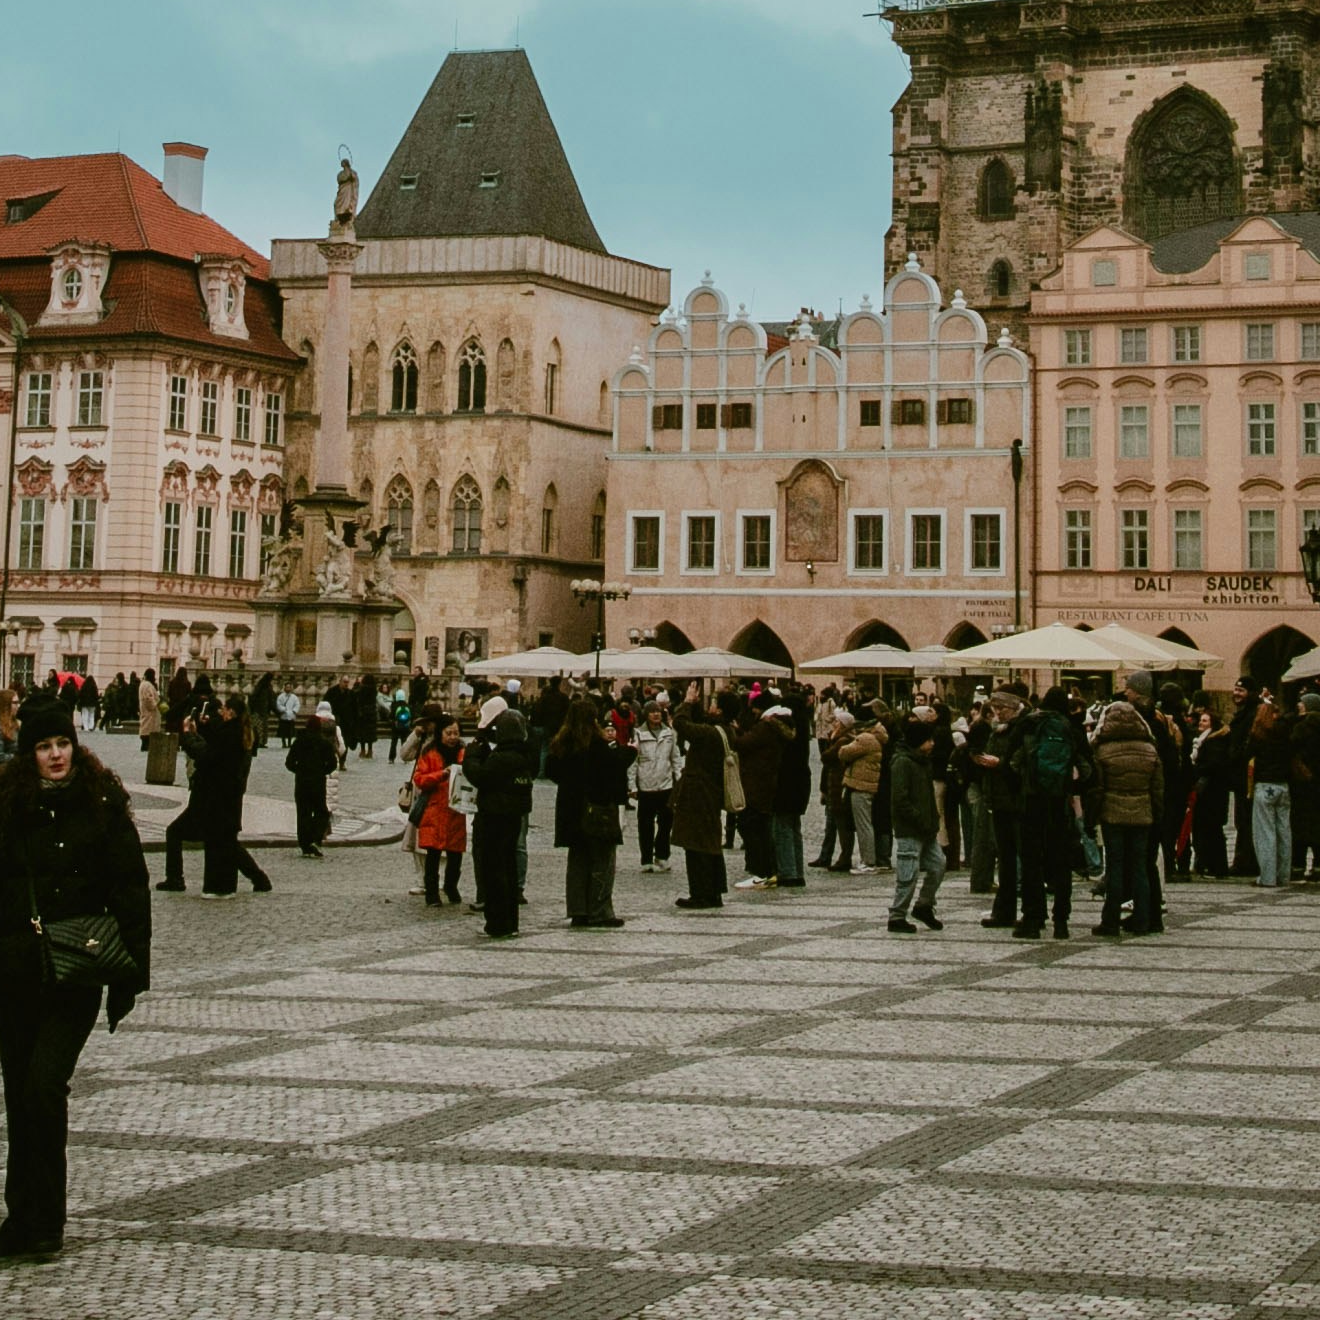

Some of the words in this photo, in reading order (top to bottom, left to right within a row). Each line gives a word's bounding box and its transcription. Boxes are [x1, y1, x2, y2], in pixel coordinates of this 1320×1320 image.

[1206, 576, 1274, 591] SAUDEK
[1203, 592, 1279, 604] exhibition
[1058, 611, 1131, 621] RESTAURANT
